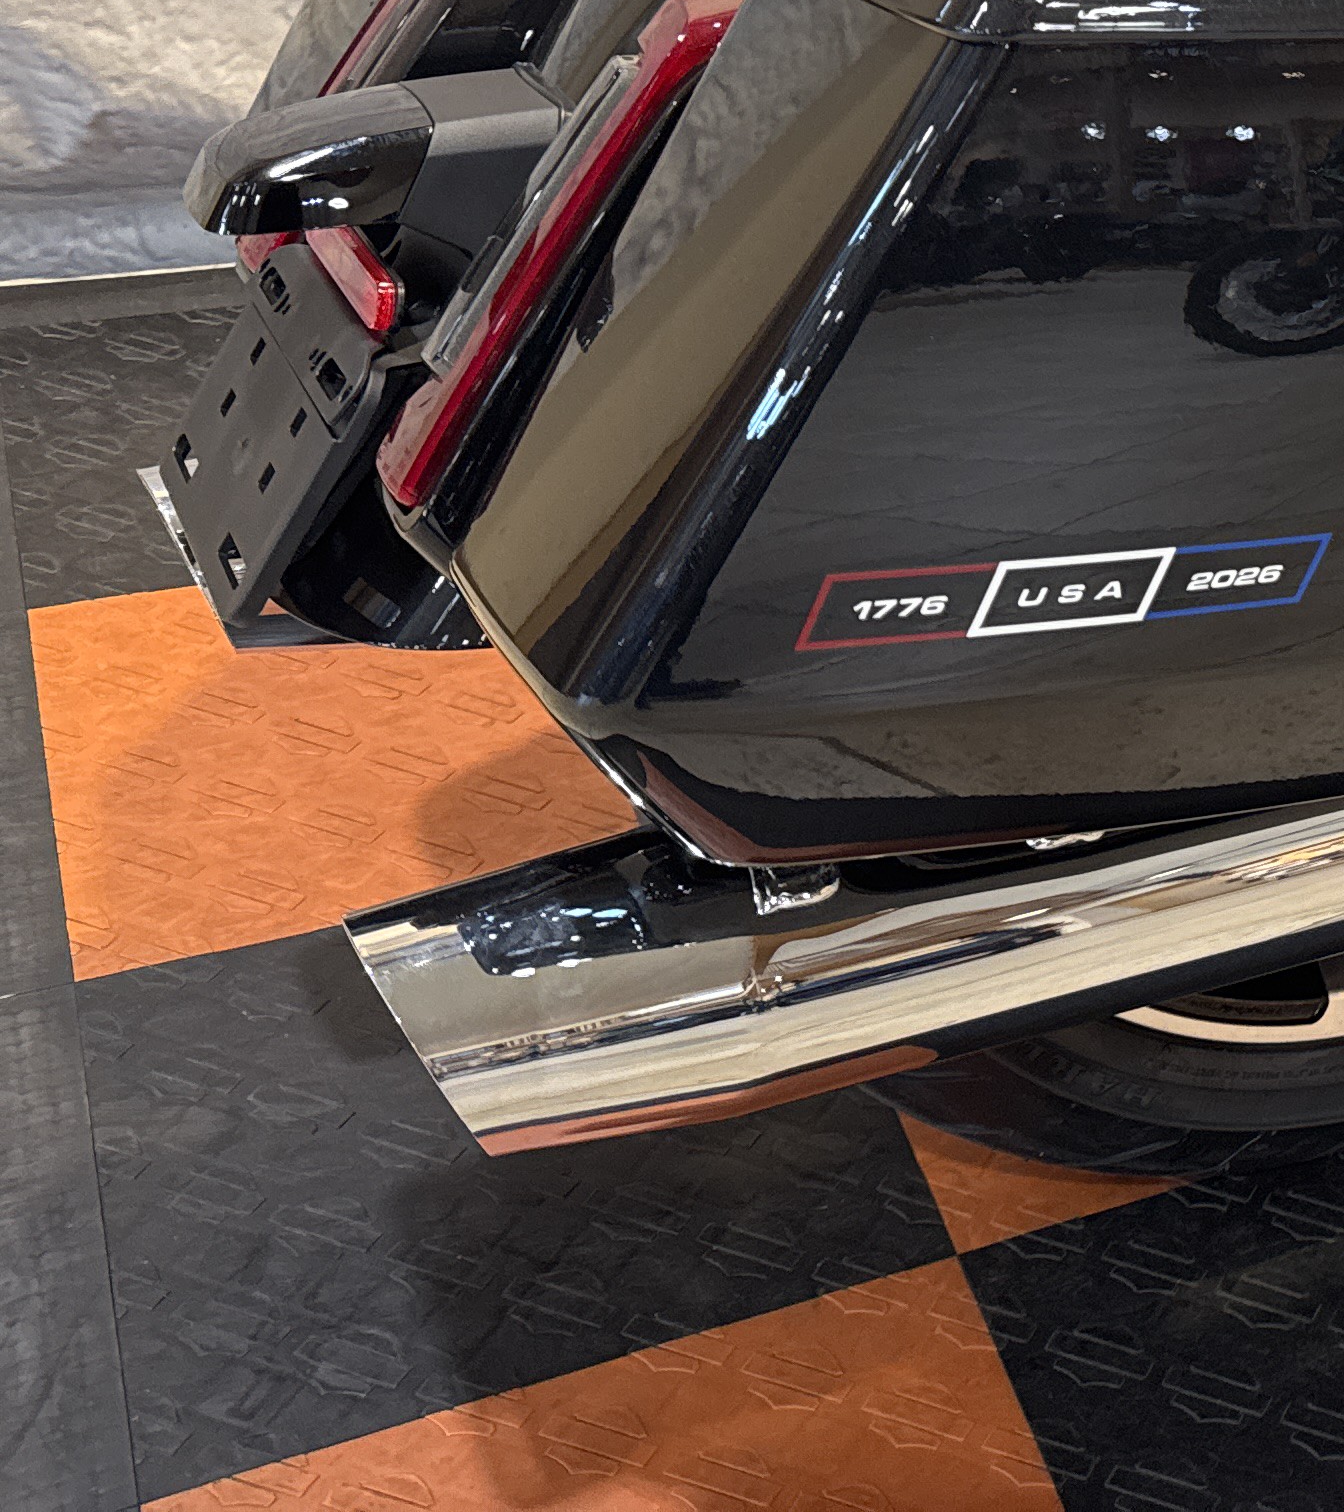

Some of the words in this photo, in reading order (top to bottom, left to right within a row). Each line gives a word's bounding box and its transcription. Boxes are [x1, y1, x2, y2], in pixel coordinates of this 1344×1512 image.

[852, 595, 949, 620] 1776
[1016, 580, 1124, 608] USA
[1186, 564, 1285, 592] 2026
